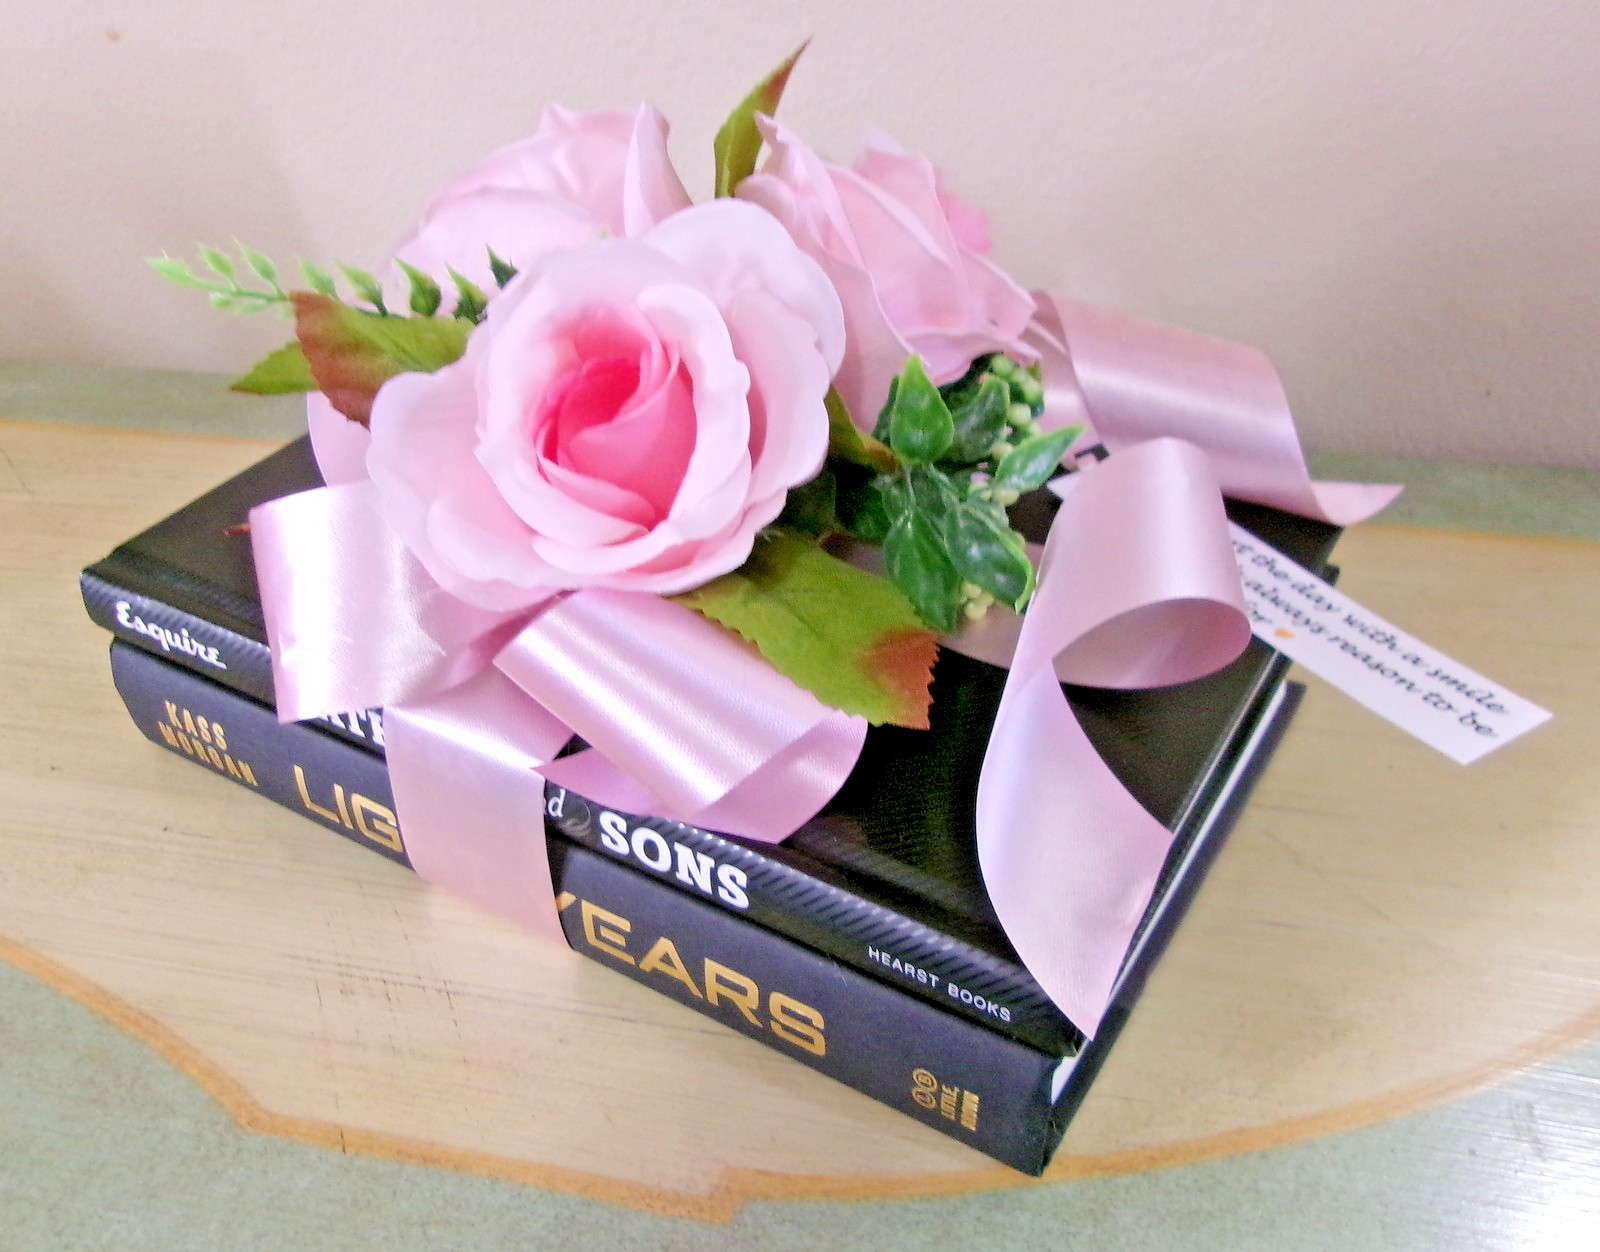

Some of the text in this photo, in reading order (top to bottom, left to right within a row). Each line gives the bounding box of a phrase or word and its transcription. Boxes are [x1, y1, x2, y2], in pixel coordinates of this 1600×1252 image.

[115, 600, 228, 670] Esquire
[1290, 584, 1340, 612] day
[1425, 670, 1509, 715] smile
[164, 699, 228, 751] KASS
[1327, 635, 1421, 692] reason
[1422, 692, 1456, 712] to
[1458, 709, 1497, 738] be
[158, 720, 258, 786] MORGAN
[599, 810, 750, 909] SONS
[868, 945, 1011, 1022] HEARST BOOKS
